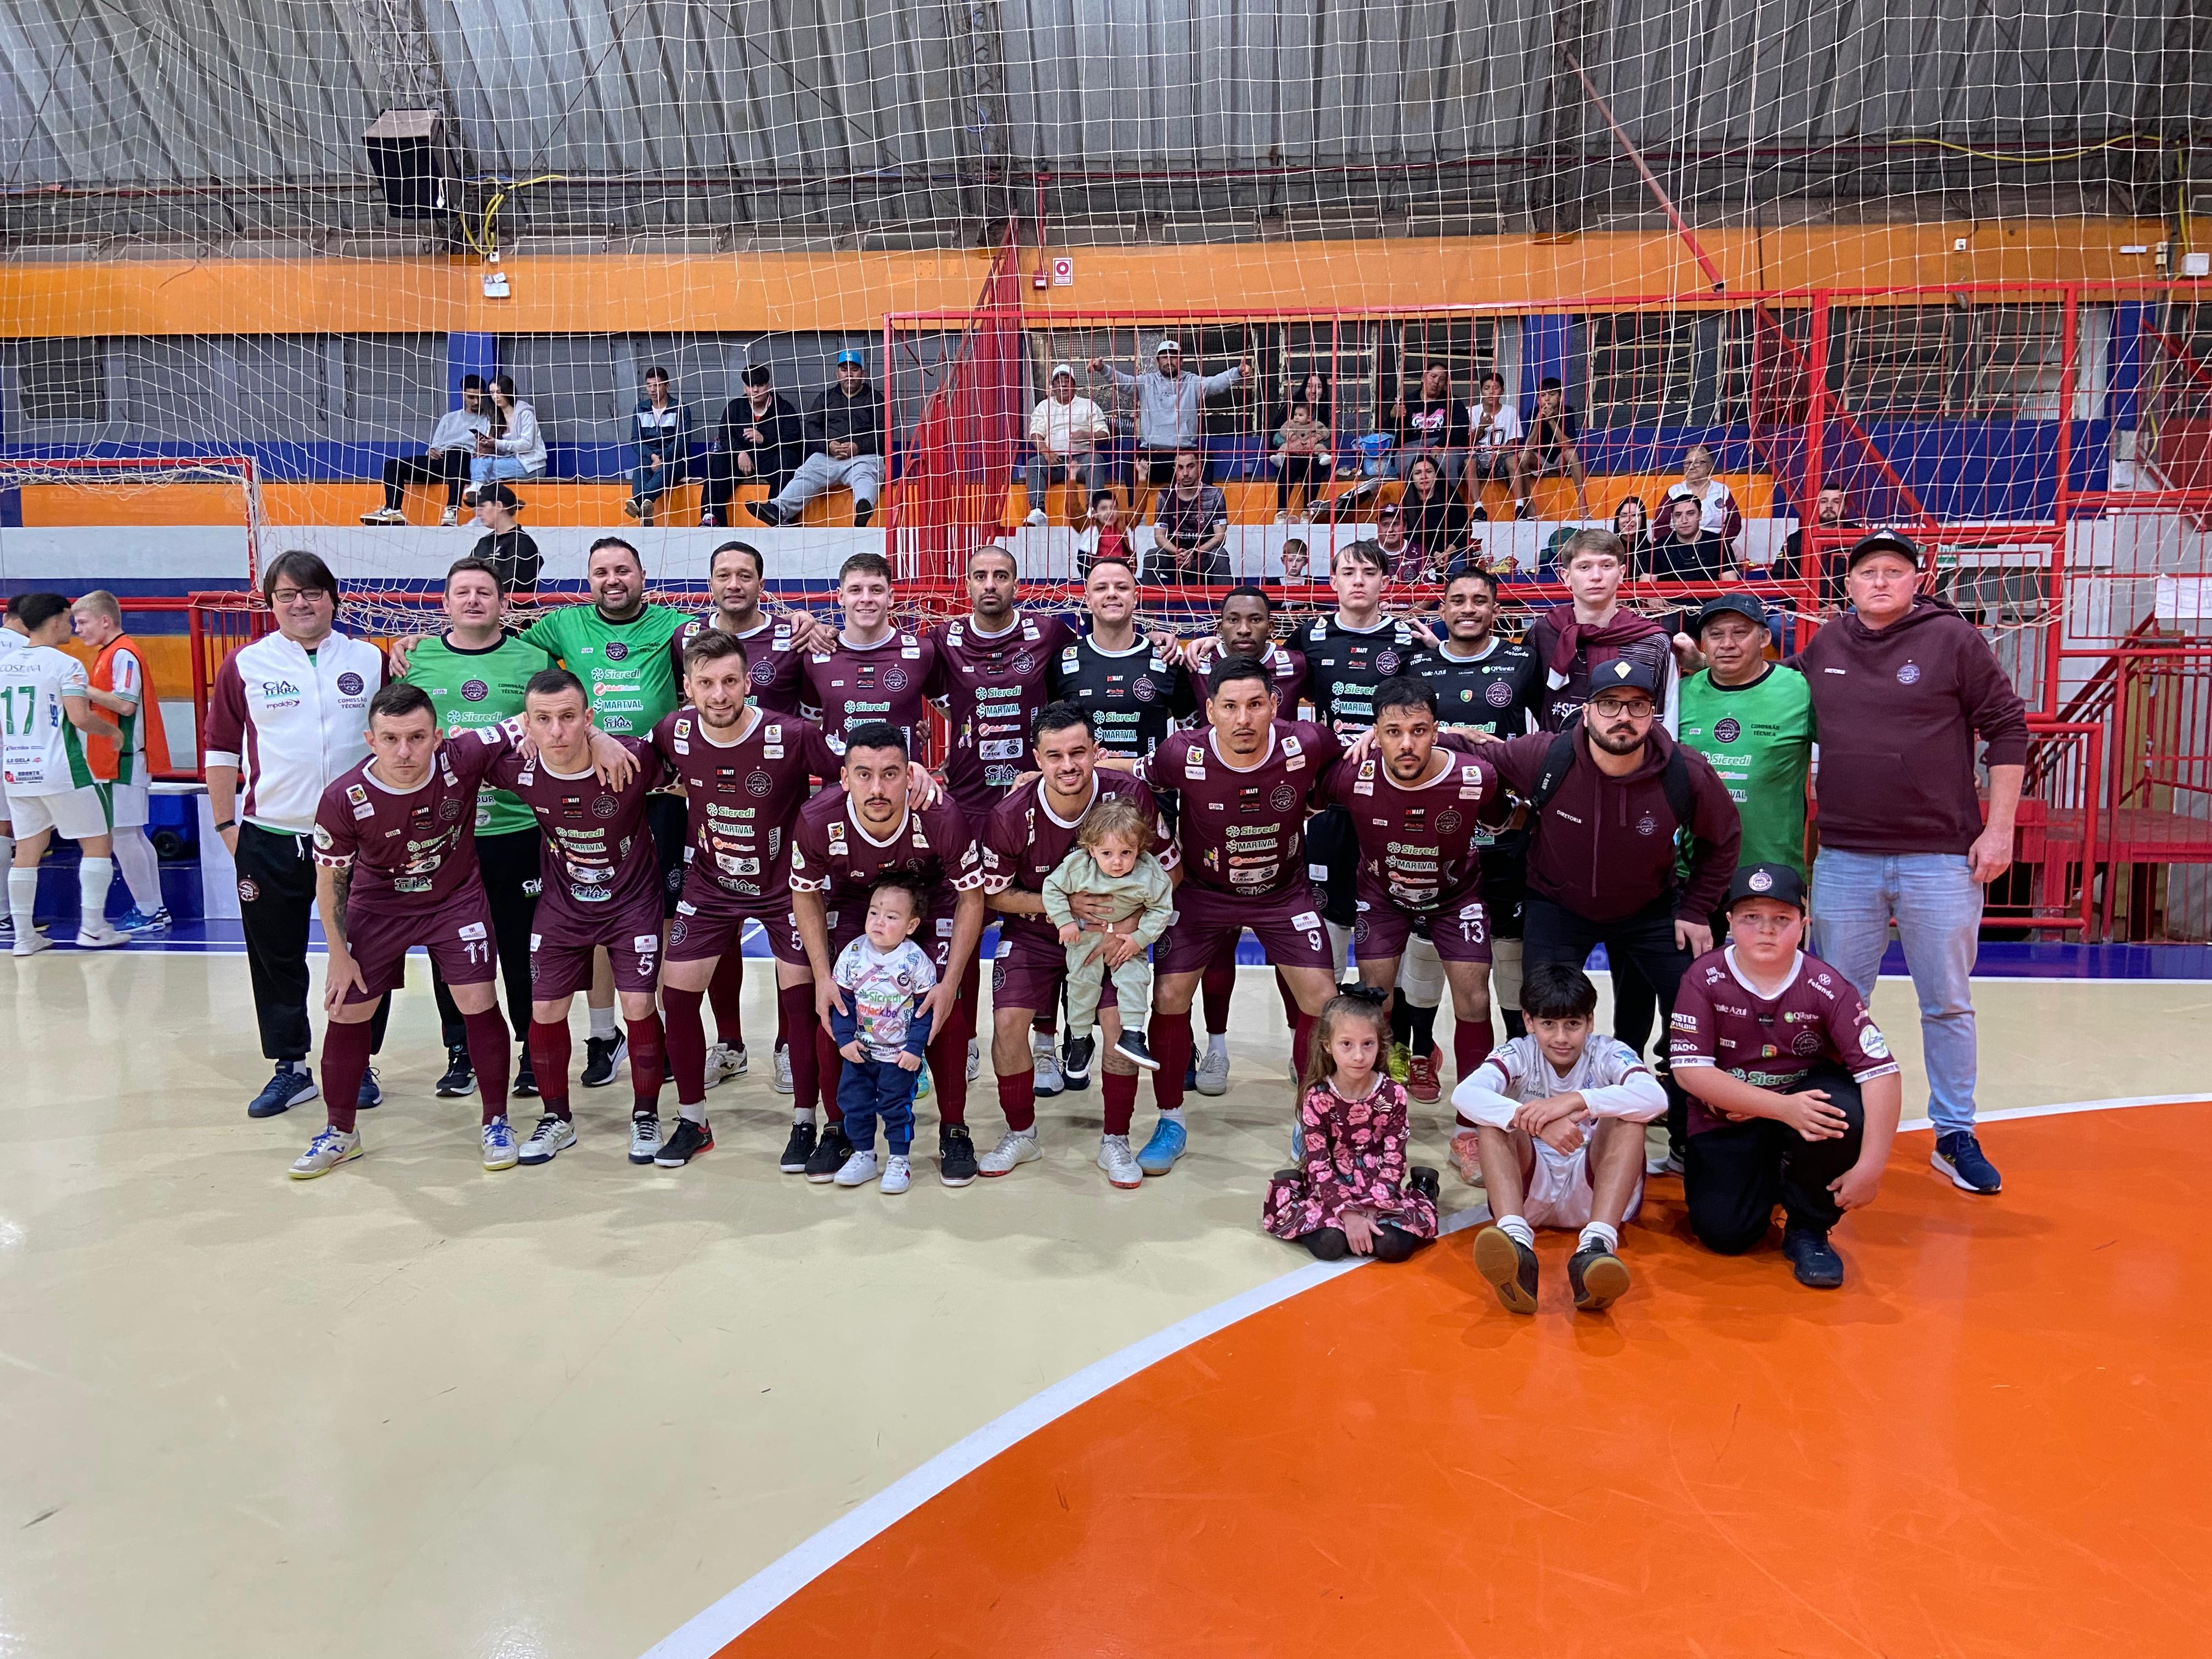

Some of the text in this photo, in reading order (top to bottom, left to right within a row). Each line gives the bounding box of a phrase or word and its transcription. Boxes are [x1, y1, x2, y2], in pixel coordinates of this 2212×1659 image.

[605, 669, 641, 679] Sicredi
[988, 686, 1022, 698] Sicredi
[1344, 684, 1378, 695] Sicred
[604, 700, 642, 709] MARTVAL
[856, 702, 890, 712] Sicredi
[986, 703, 1020, 714] MARTVAL
[1341, 703, 1373, 712] MARTVA
[1, 686, 35, 736] 17
[461, 712, 502, 722] Sicredi
[1105, 712, 1140, 722] Sicredi
[1104, 730, 1137, 739] MARTVAL
[1710, 754, 1751, 765] Sicredi
[719, 806, 755, 818] Sicredi
[1557, 810, 1582, 824] DIRETORIA
[568, 828, 604, 838] Sicredi
[718, 824, 754, 834] MARTVAL
[1240, 823, 1280, 835] Sicredi
[568, 842, 606, 851] MARTVAL
[1239, 838, 1277, 849] MARTVAL
[1401, 845, 1439, 856] Sicred
[1397, 860, 1438, 870] MARTVAL
[1459, 921, 1485, 944] 13
[791, 930, 803, 951] 5
[1307, 930, 1323, 952] 9
[463, 940, 490, 966] 11
[936, 941, 950, 965] 2
[636, 953, 655, 976] 5
[869, 992, 901, 1003] Sicredi
[1729, 1006, 1747, 1016] Azul
